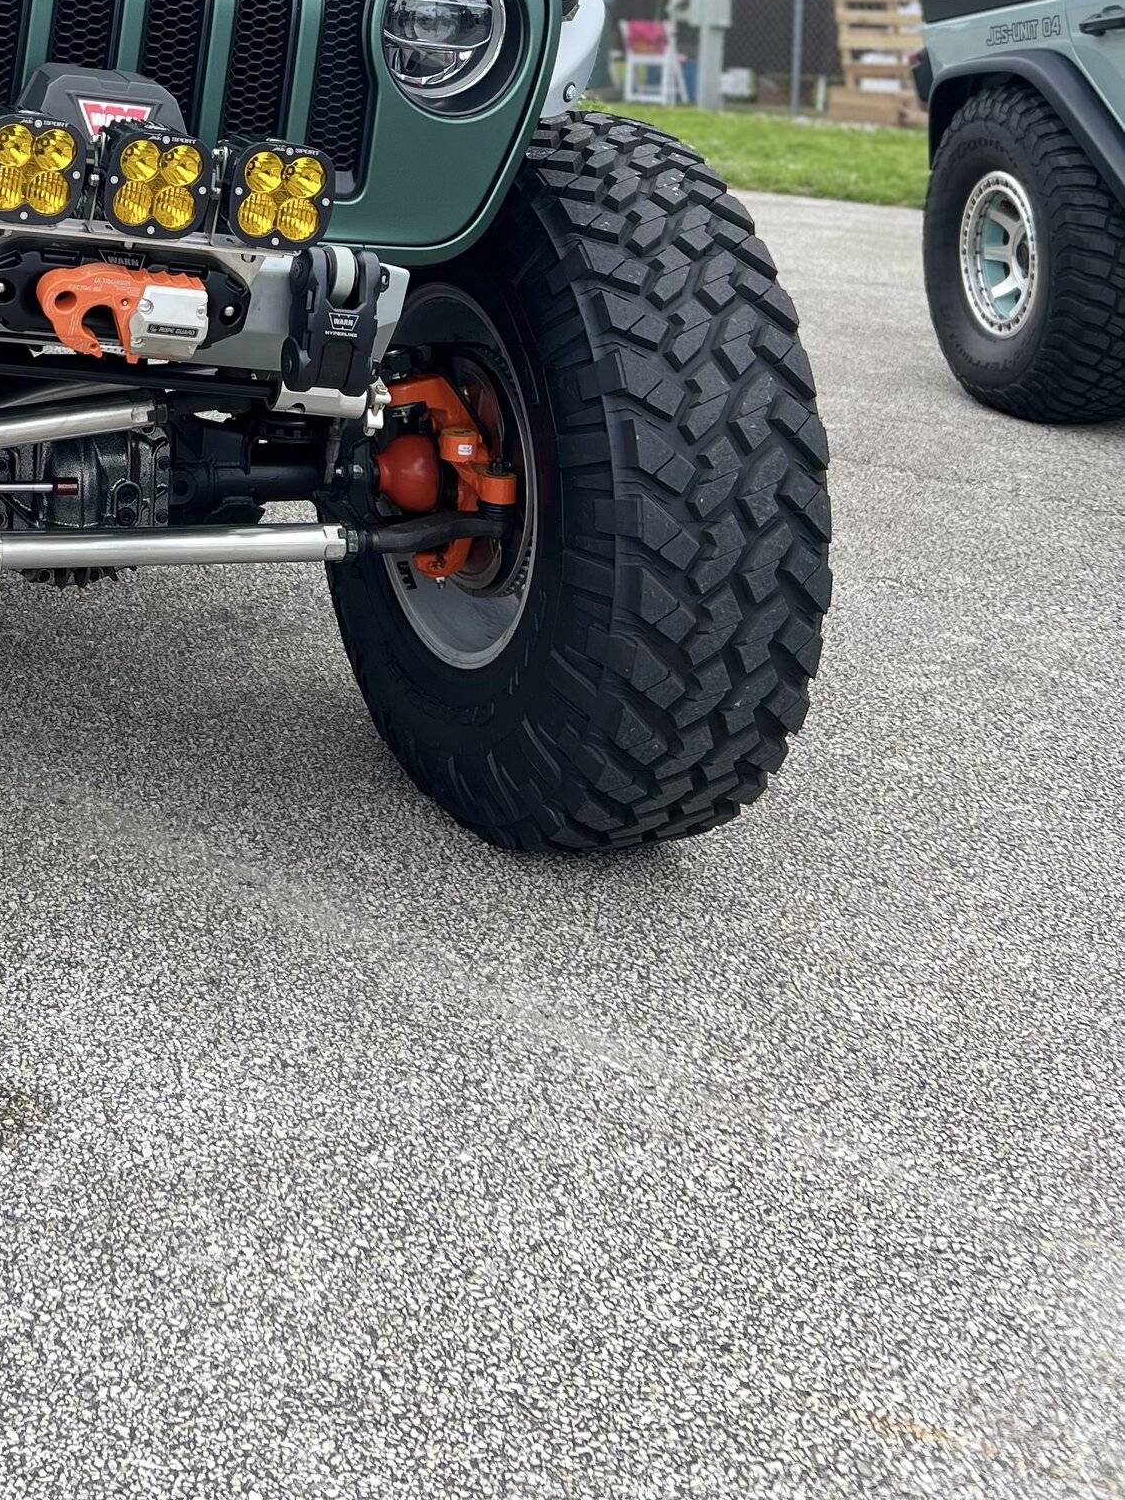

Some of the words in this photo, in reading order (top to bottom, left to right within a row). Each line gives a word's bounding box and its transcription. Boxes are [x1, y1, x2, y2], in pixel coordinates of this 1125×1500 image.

[986, 19, 1039, 46] JCS-UNIT
[1041, 14, 1061, 38] 04
[107, 255, 140, 267] WARN
[333, 317, 355, 327] WARN
